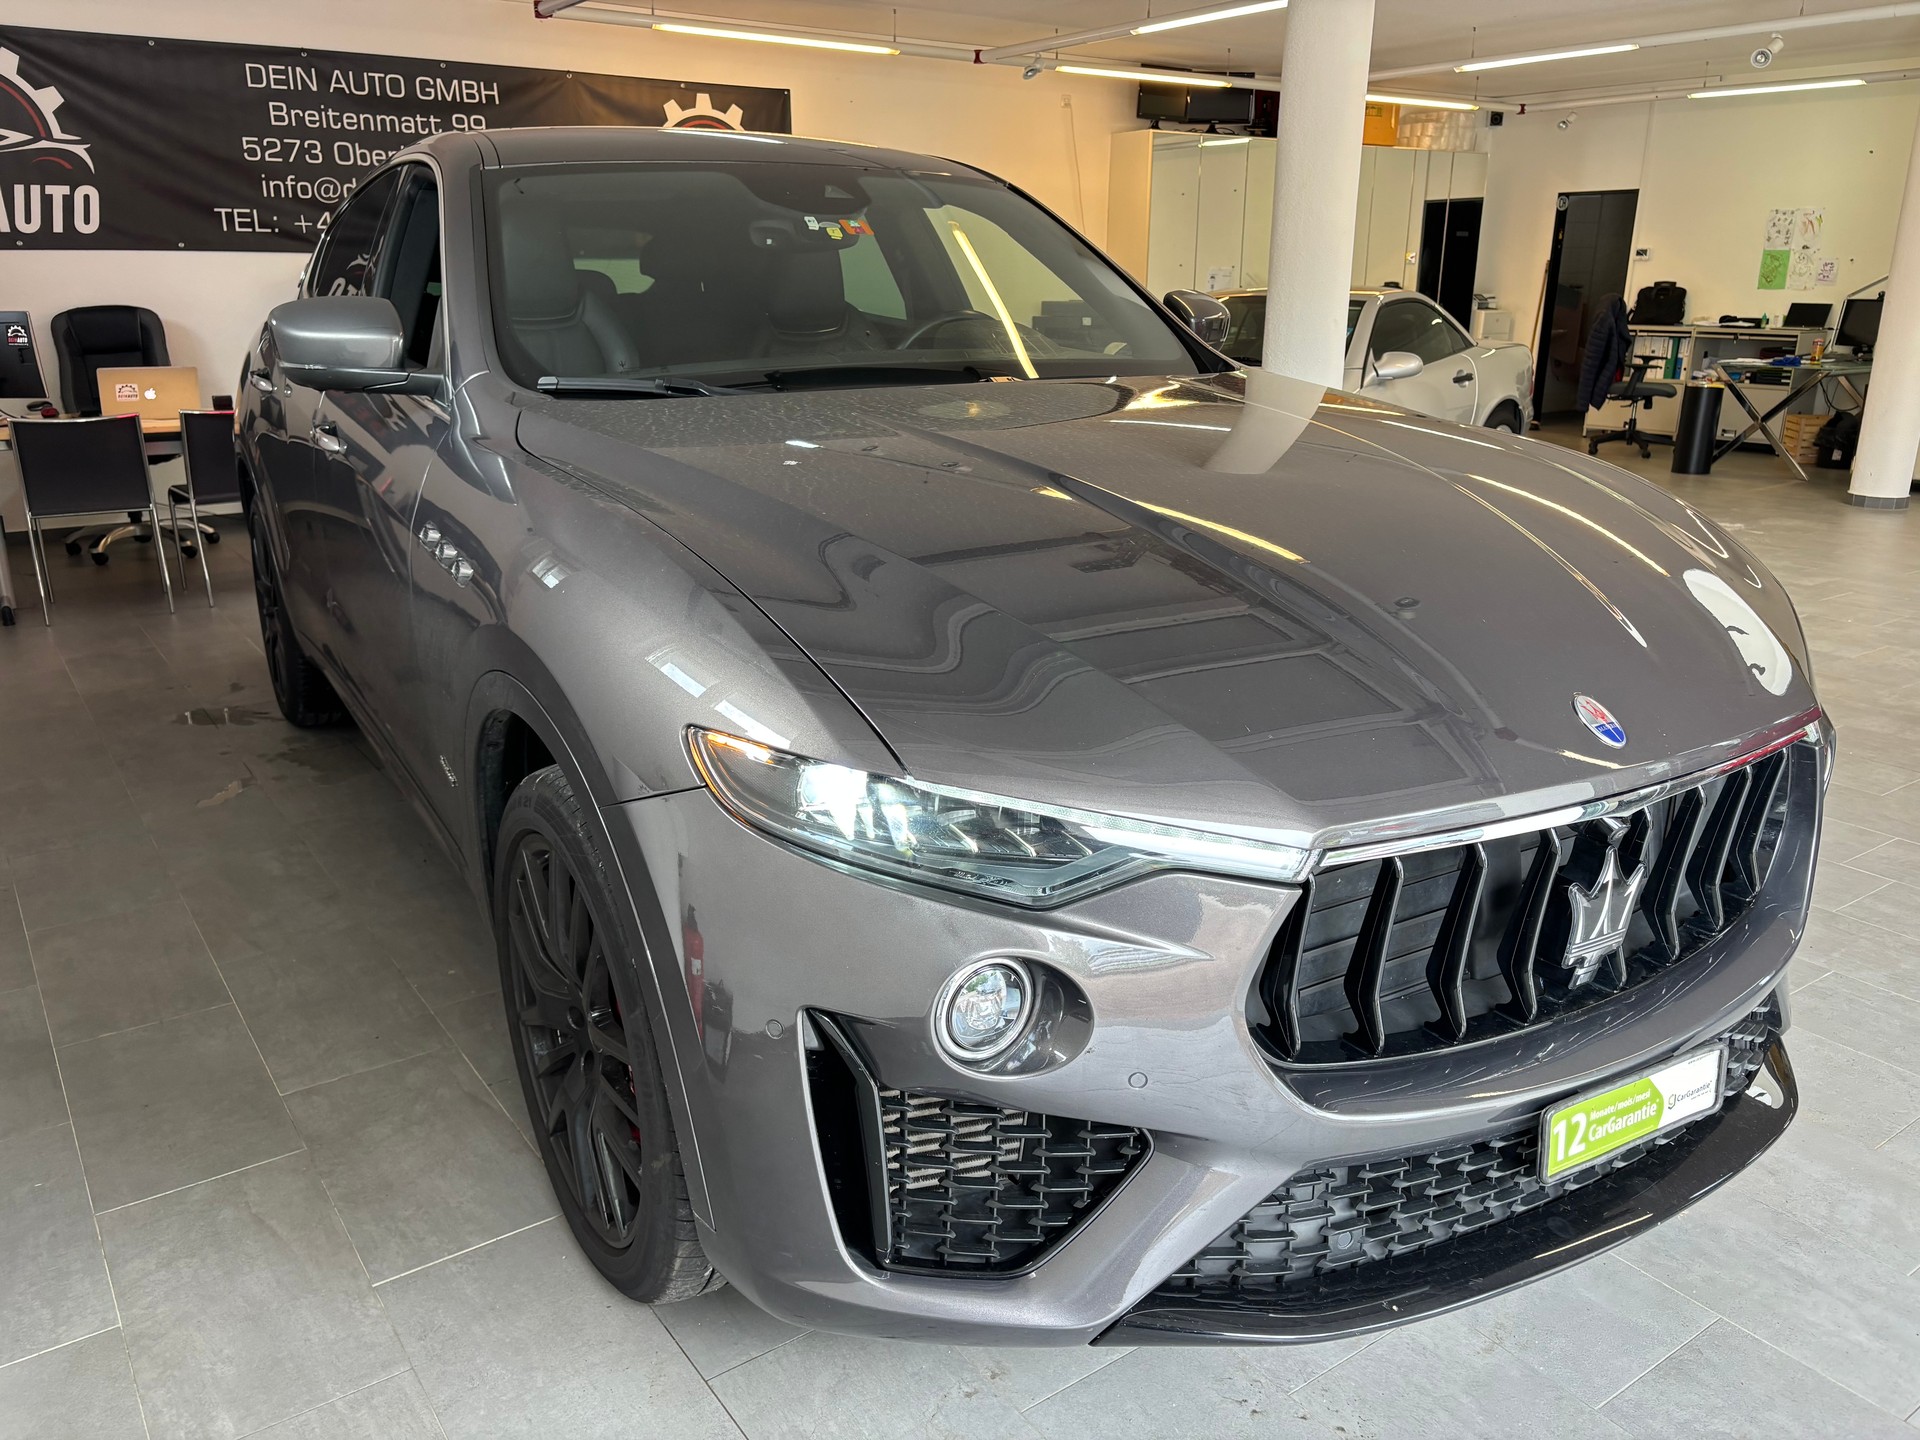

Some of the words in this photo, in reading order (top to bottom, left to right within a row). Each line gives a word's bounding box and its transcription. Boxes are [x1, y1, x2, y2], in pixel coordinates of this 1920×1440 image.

[245, 63, 318, 92] DEIN
[329, 69, 405, 98] AUTO
[415, 76, 500, 105] GMBH
[268, 101, 443, 135] Breitenmatt
[242, 136, 323, 164] 5273
[213, 207, 280, 233] TEL:
[1552, 1112, 1587, 1162] 12
